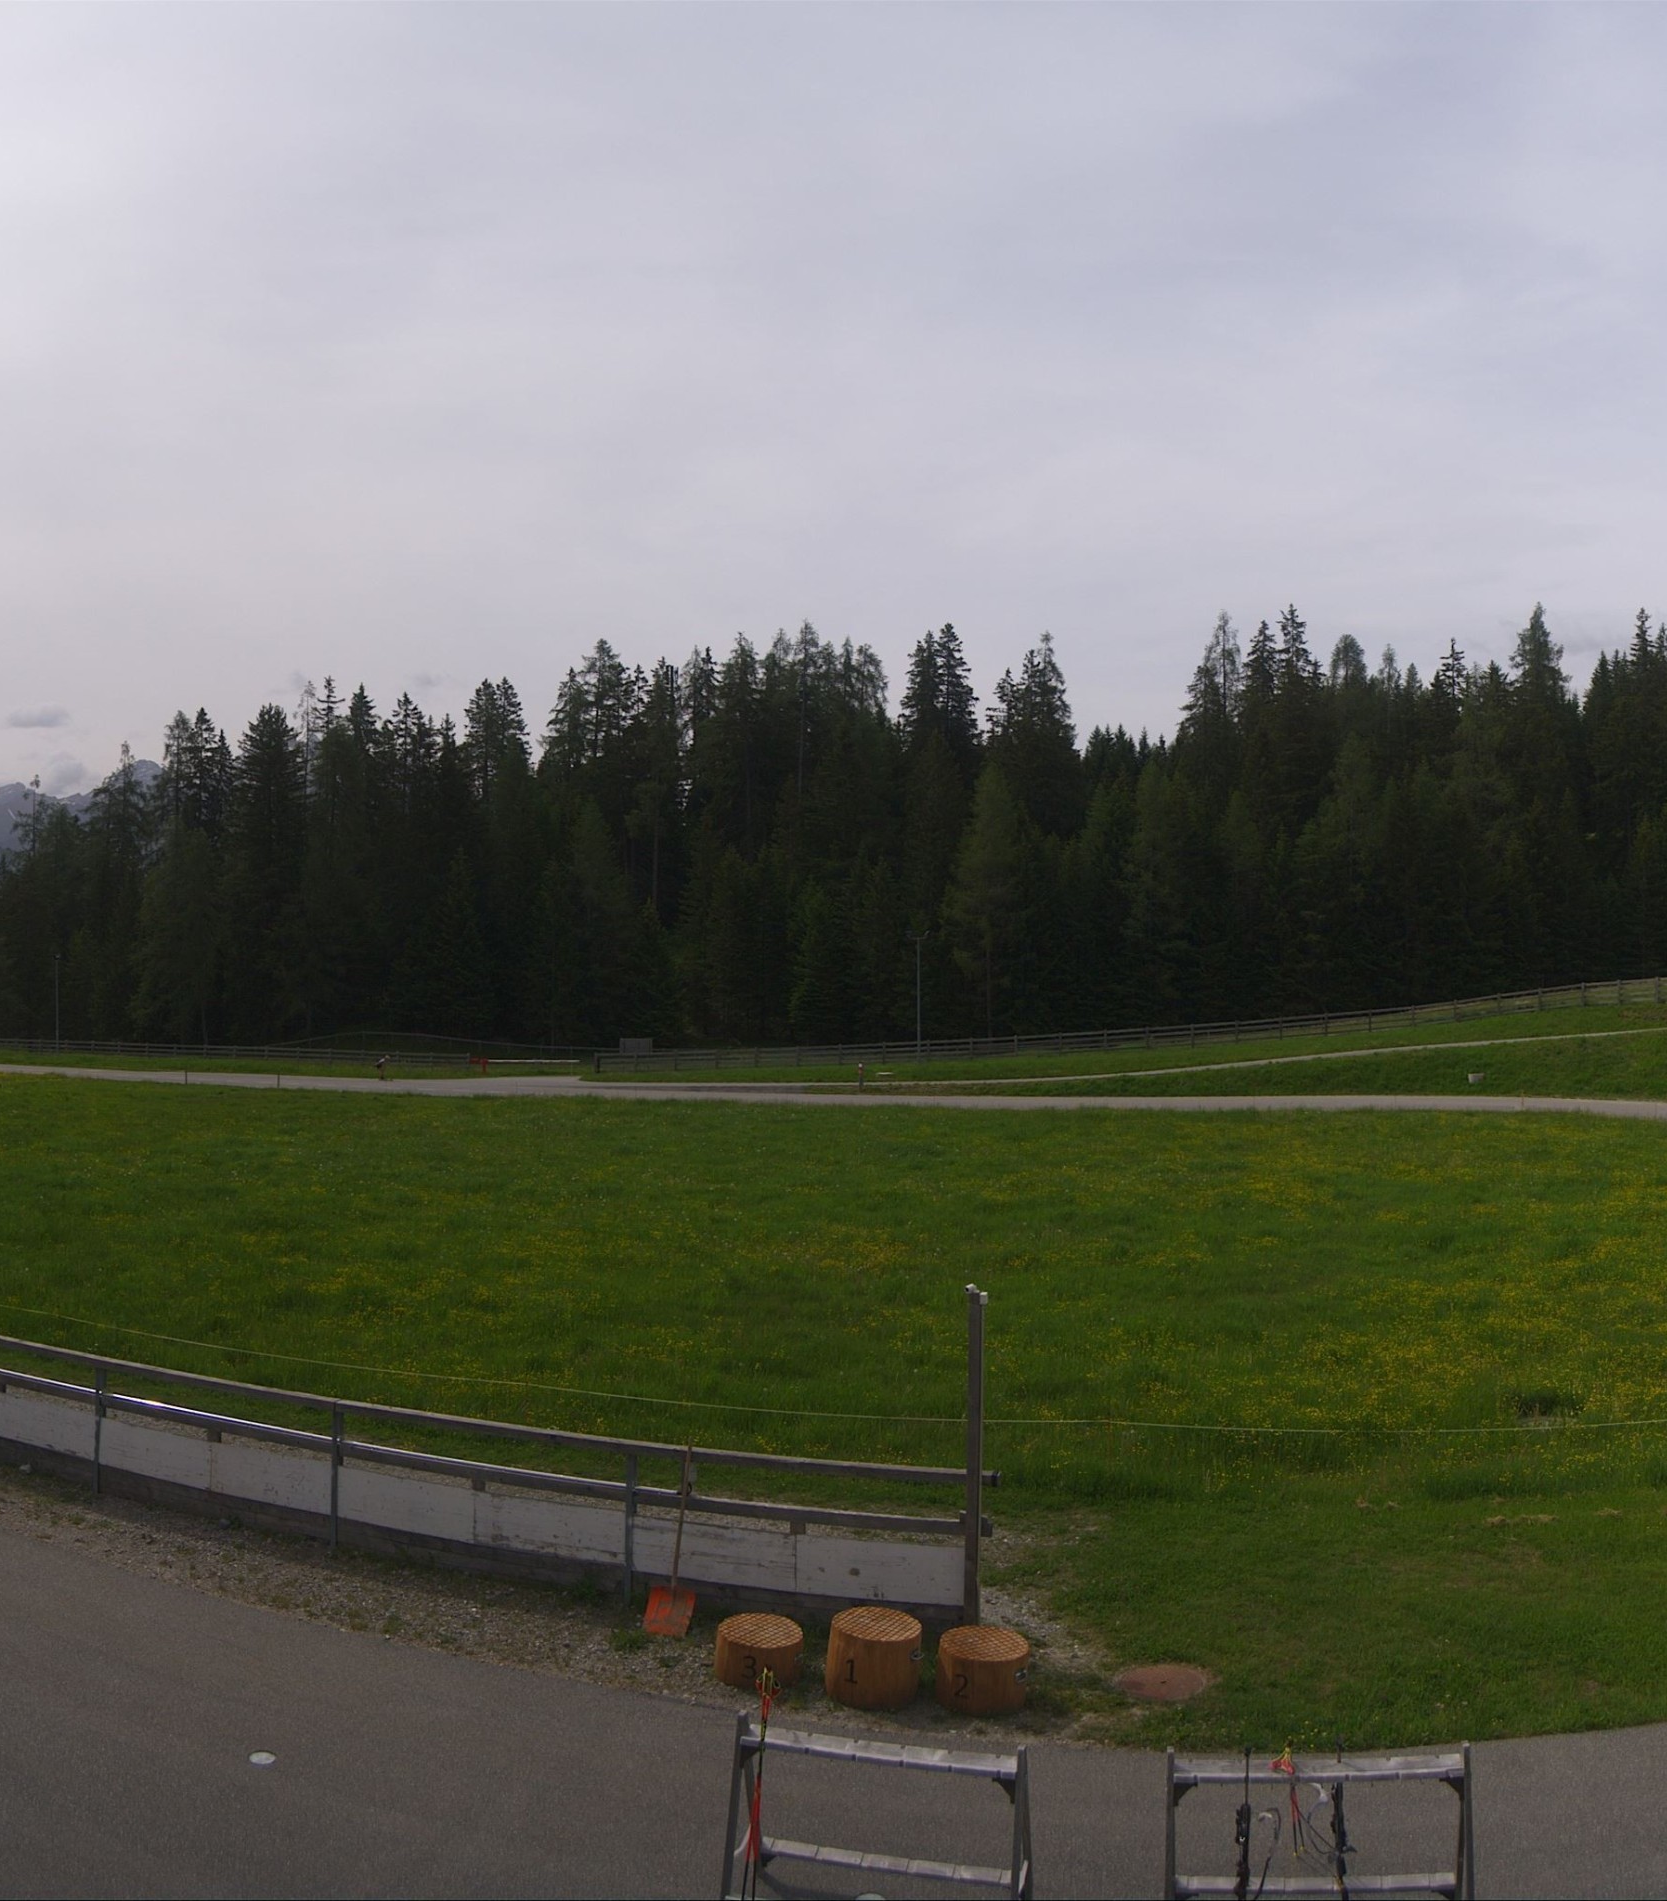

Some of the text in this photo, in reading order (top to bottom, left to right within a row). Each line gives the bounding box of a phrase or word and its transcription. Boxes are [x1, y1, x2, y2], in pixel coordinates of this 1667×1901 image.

[741, 1655, 757, 1680] 3
[844, 1659, 858, 1685] 1
[954, 1674, 968, 1697] 2
